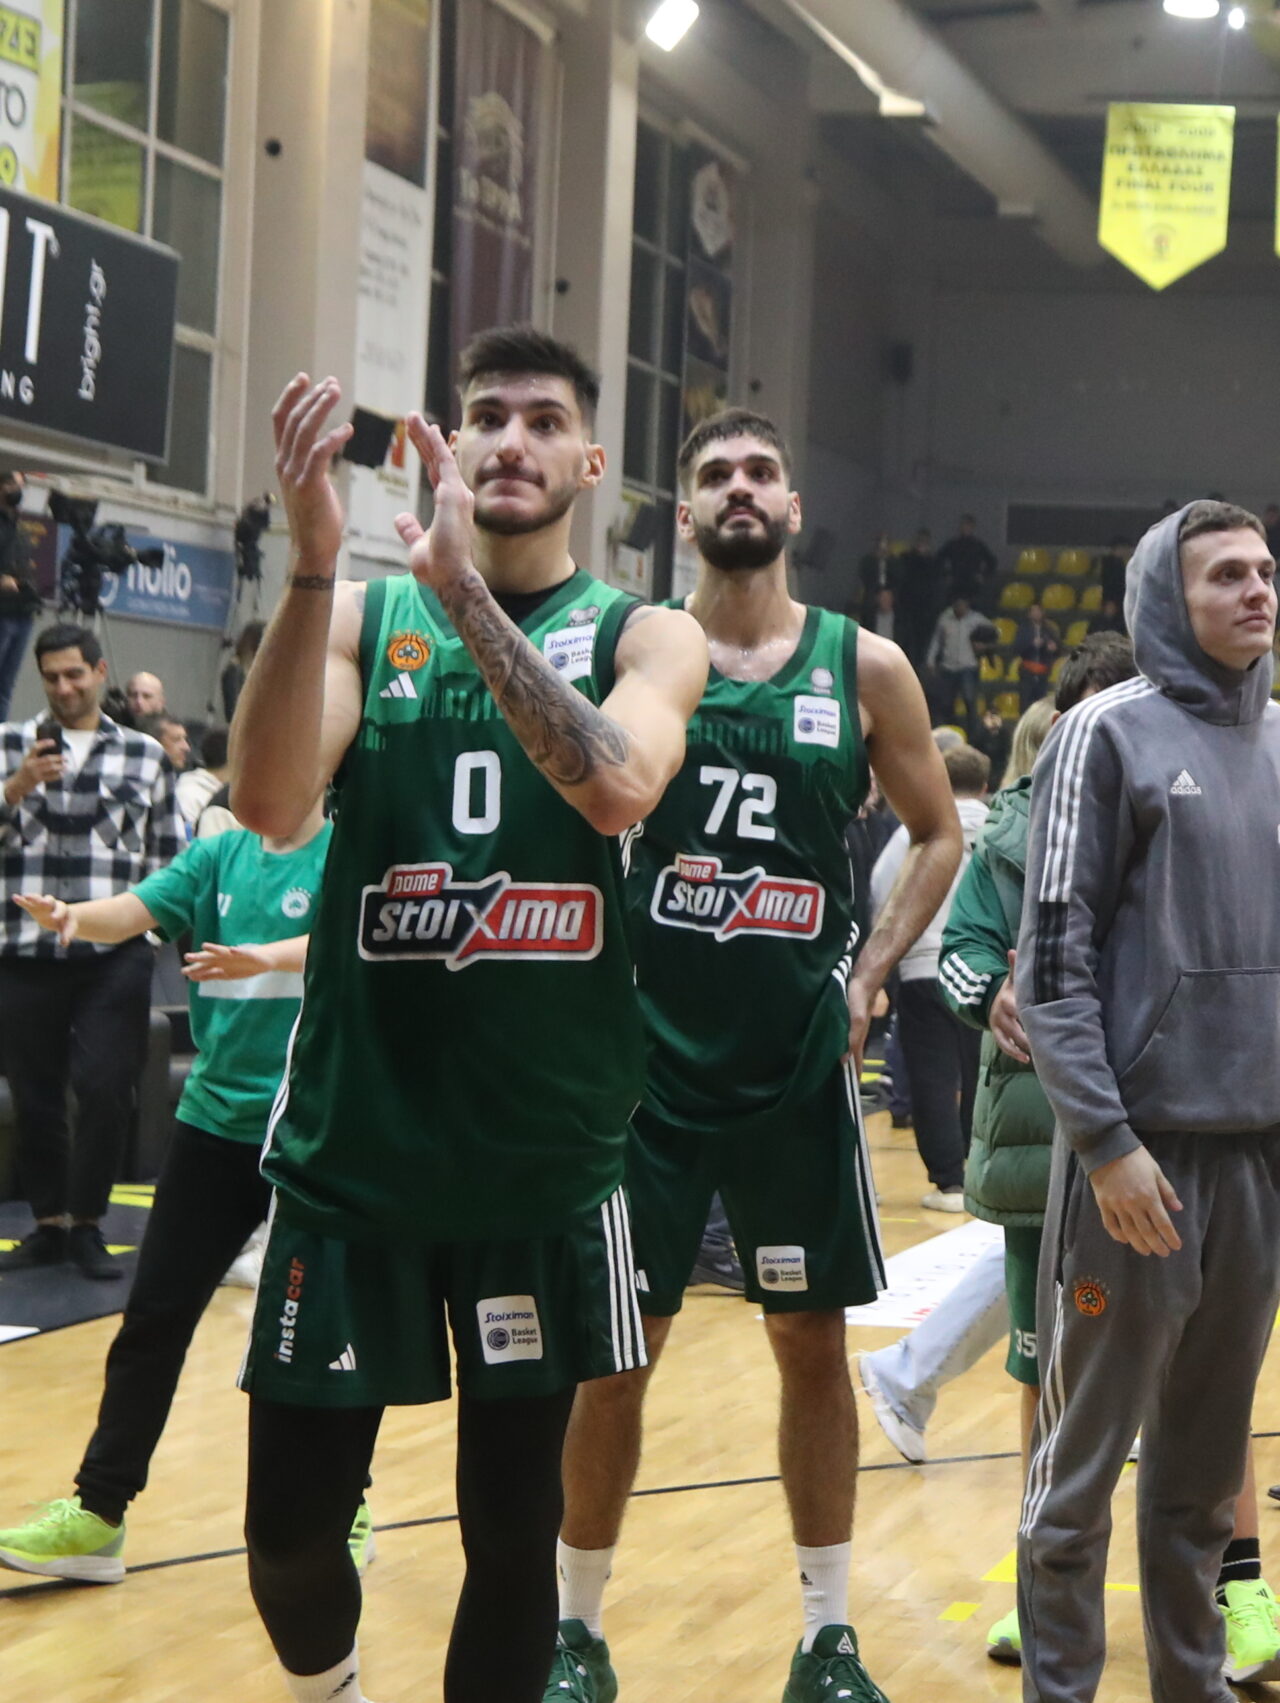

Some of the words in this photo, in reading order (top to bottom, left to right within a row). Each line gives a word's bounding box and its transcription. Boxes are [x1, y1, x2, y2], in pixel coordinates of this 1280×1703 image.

[452, 750, 501, 834] 0
[1170, 785, 1202, 795] adidas
[699, 765, 777, 841] 72
[393, 872, 439, 892] pame
[273, 1256, 307, 1364] instacar
[484, 1311, 534, 1324] Stoiximan
[511, 1327, 538, 1337] Basket
[512, 1336, 539, 1345] League
